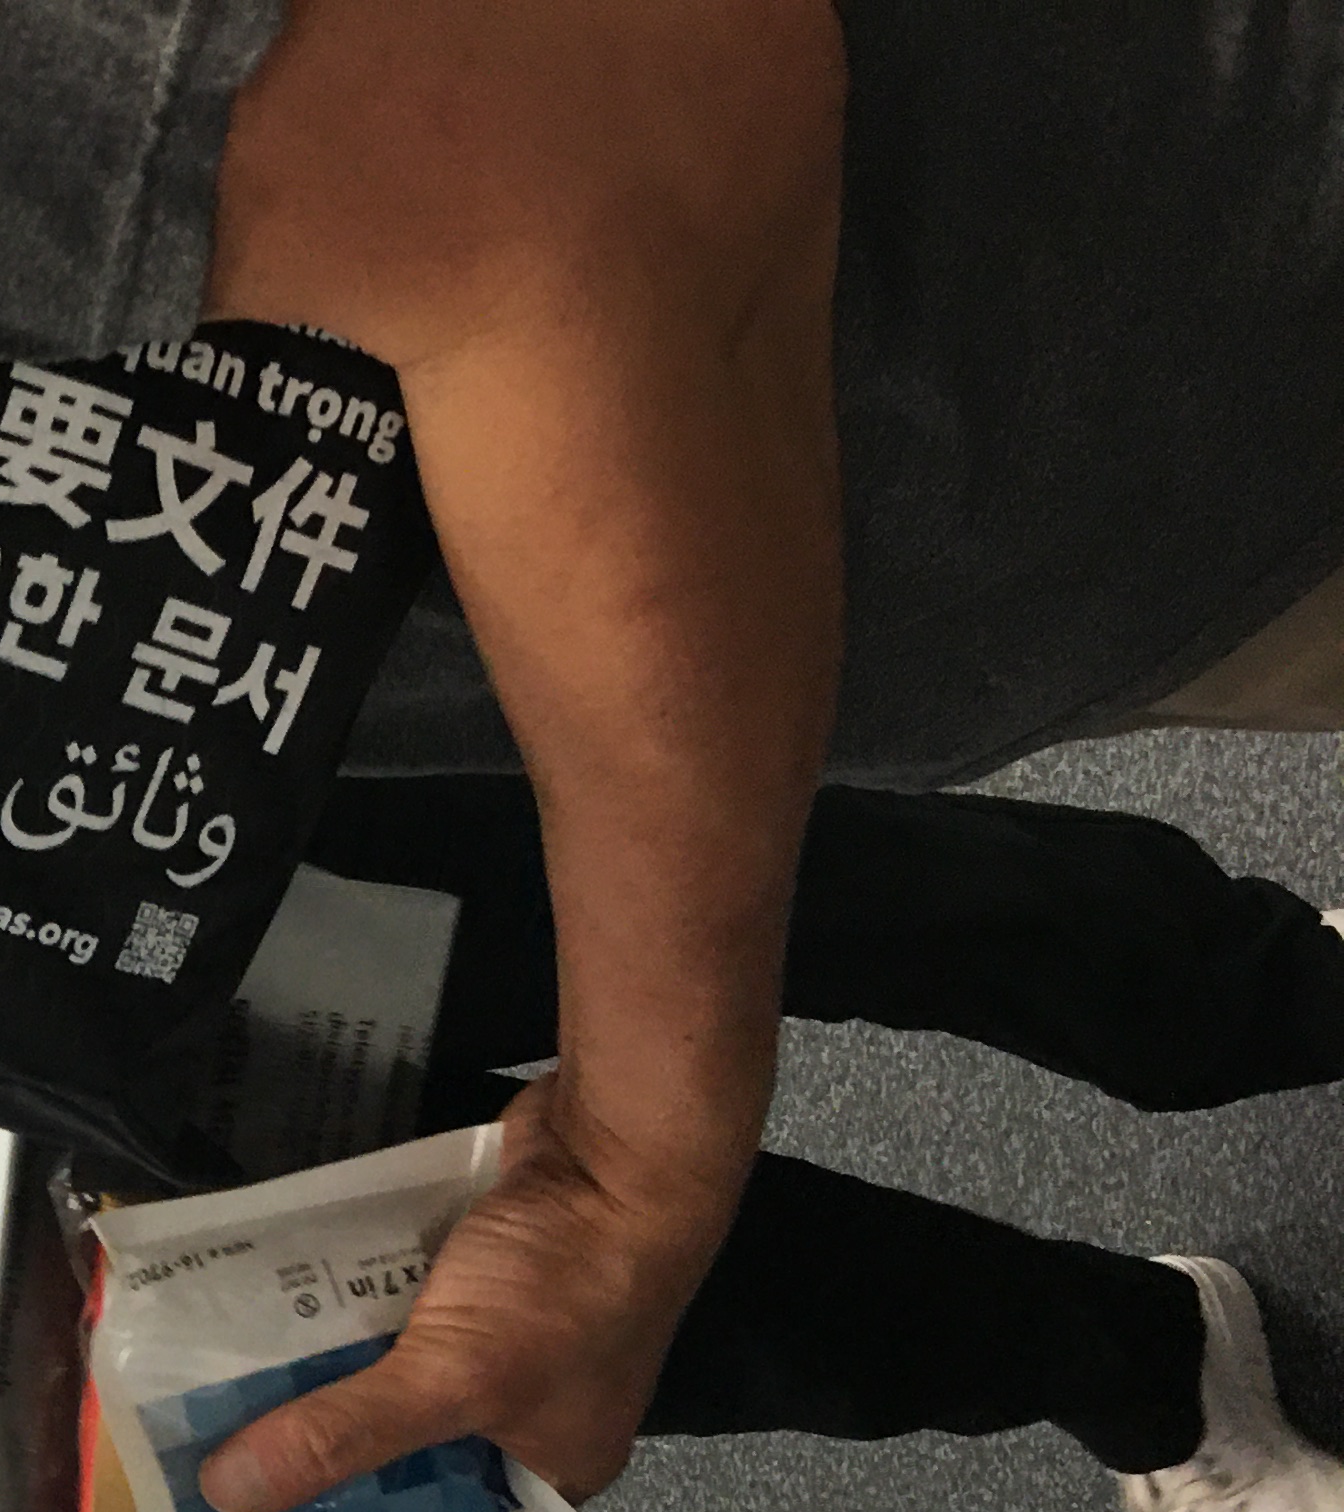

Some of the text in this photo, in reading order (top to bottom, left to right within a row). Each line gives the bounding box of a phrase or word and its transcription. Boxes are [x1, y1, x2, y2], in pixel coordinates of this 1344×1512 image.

[256, 357, 404, 463] trọng
[119, 593, 324, 756] 문서
[346, 1275, 379, 1300] in
